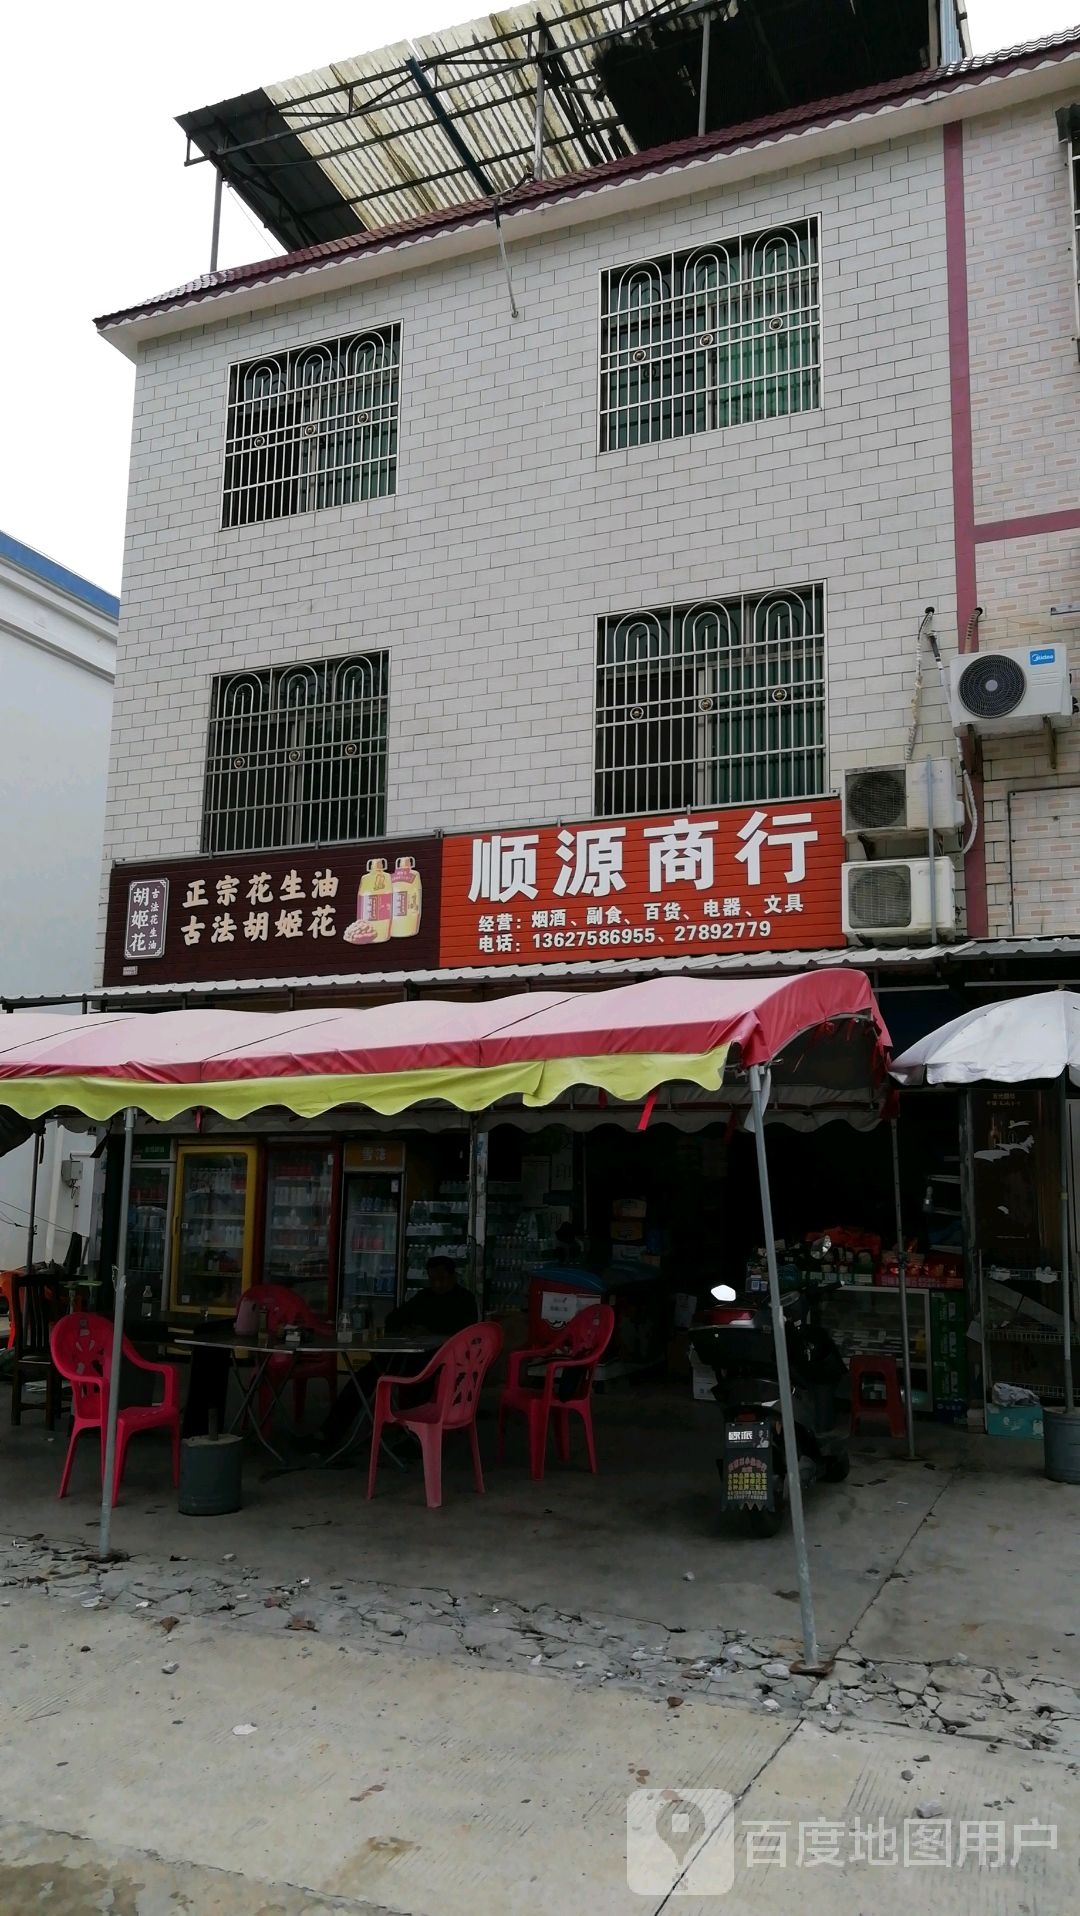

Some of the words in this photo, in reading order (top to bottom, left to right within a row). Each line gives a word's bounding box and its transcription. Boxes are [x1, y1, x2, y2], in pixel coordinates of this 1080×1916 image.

[468, 810, 819, 903] 顺源商行
[148, 888, 160, 950] 古法花生油
[182, 868, 340, 908] 正宗花生油
[128, 887, 150, 952] 胡姬花
[180, 905, 338, 946] 古法胡姬花
